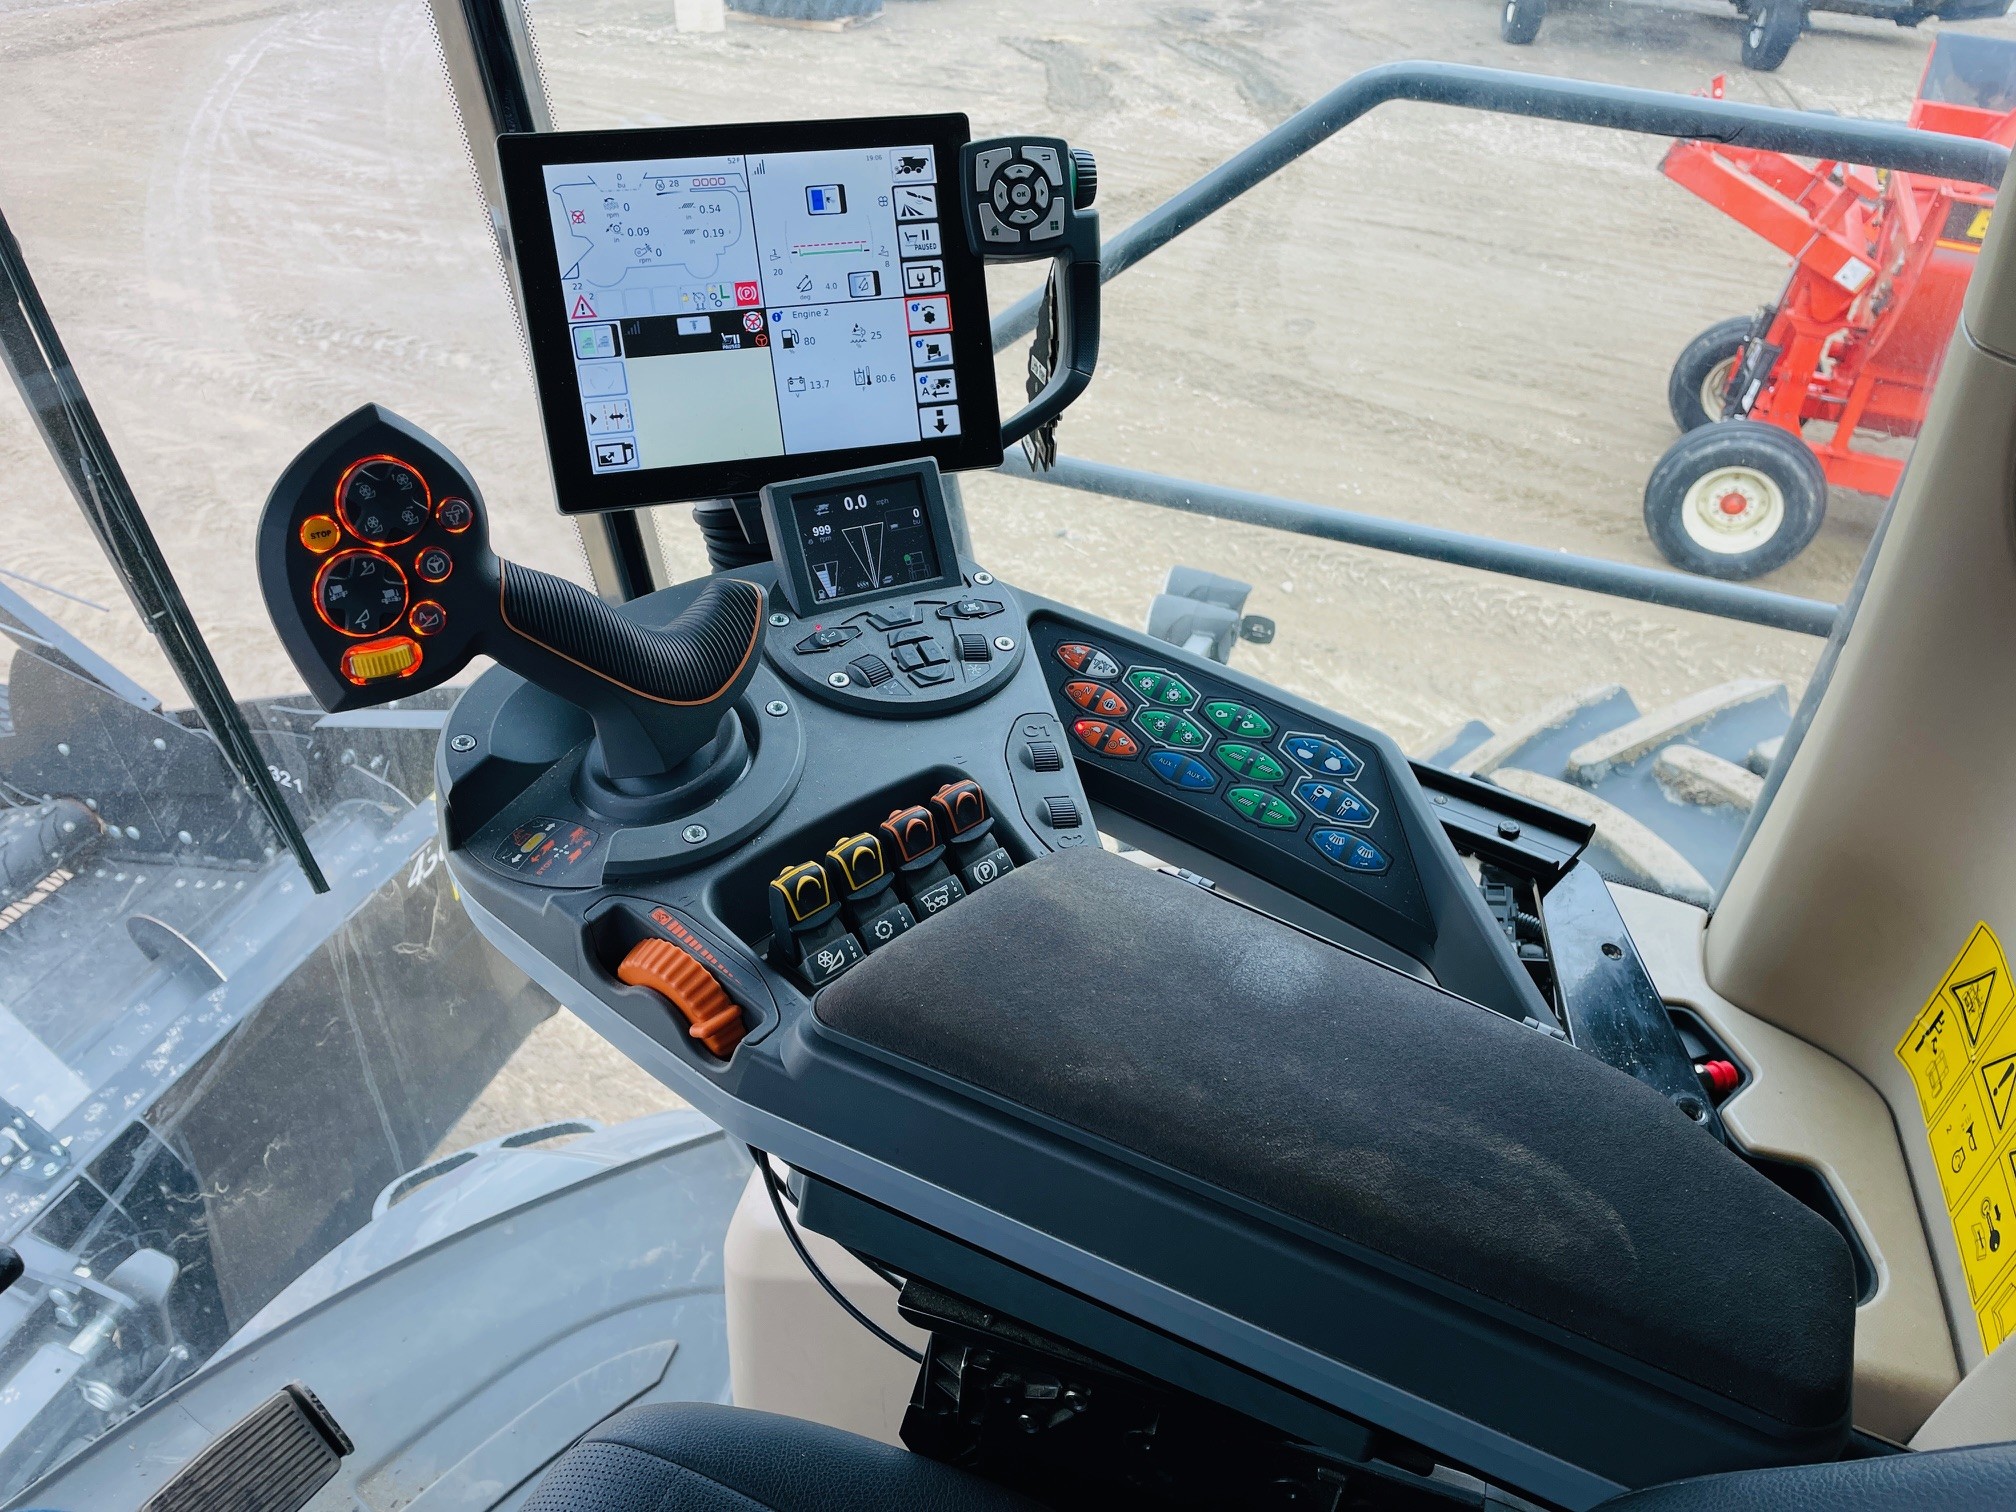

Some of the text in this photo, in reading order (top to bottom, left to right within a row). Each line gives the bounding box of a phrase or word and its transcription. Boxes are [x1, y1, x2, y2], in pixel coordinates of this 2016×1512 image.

[983, 159, 990, 168] ?
[623, 203, 630, 212] 0
[699, 205, 721, 214] 0.54
[627, 227, 650, 237] 0.09
[702, 229, 724, 238] 0.19
[914, 242, 937, 251] PAUSED
[656, 248, 662, 257] 0
[773, 268, 783, 276] 20
[825, 282, 837, 290] 4.0
[792, 309, 829, 320] Engine 2
[870, 331, 882, 340] 25
[804, 336, 816, 346] 80
[875, 374, 896, 383] 80.6
[810, 380, 830, 390] 13.7
[921, 387, 930, 396] A
[843, 494, 868, 511] 0.0
[876, 497, 889, 505] mph
[912, 508, 920, 518] 0
[310, 529, 332, 540] STOP
[812, 524, 832, 537] 999
[819, 535, 832, 543] rpm
[1083, 686, 1092, 695] N
[1023, 725, 1050, 737] C1
[1158, 757, 1172, 767] AUX
[1186, 770, 1200, 779] AUX
[982, 865, 990, 879] P
